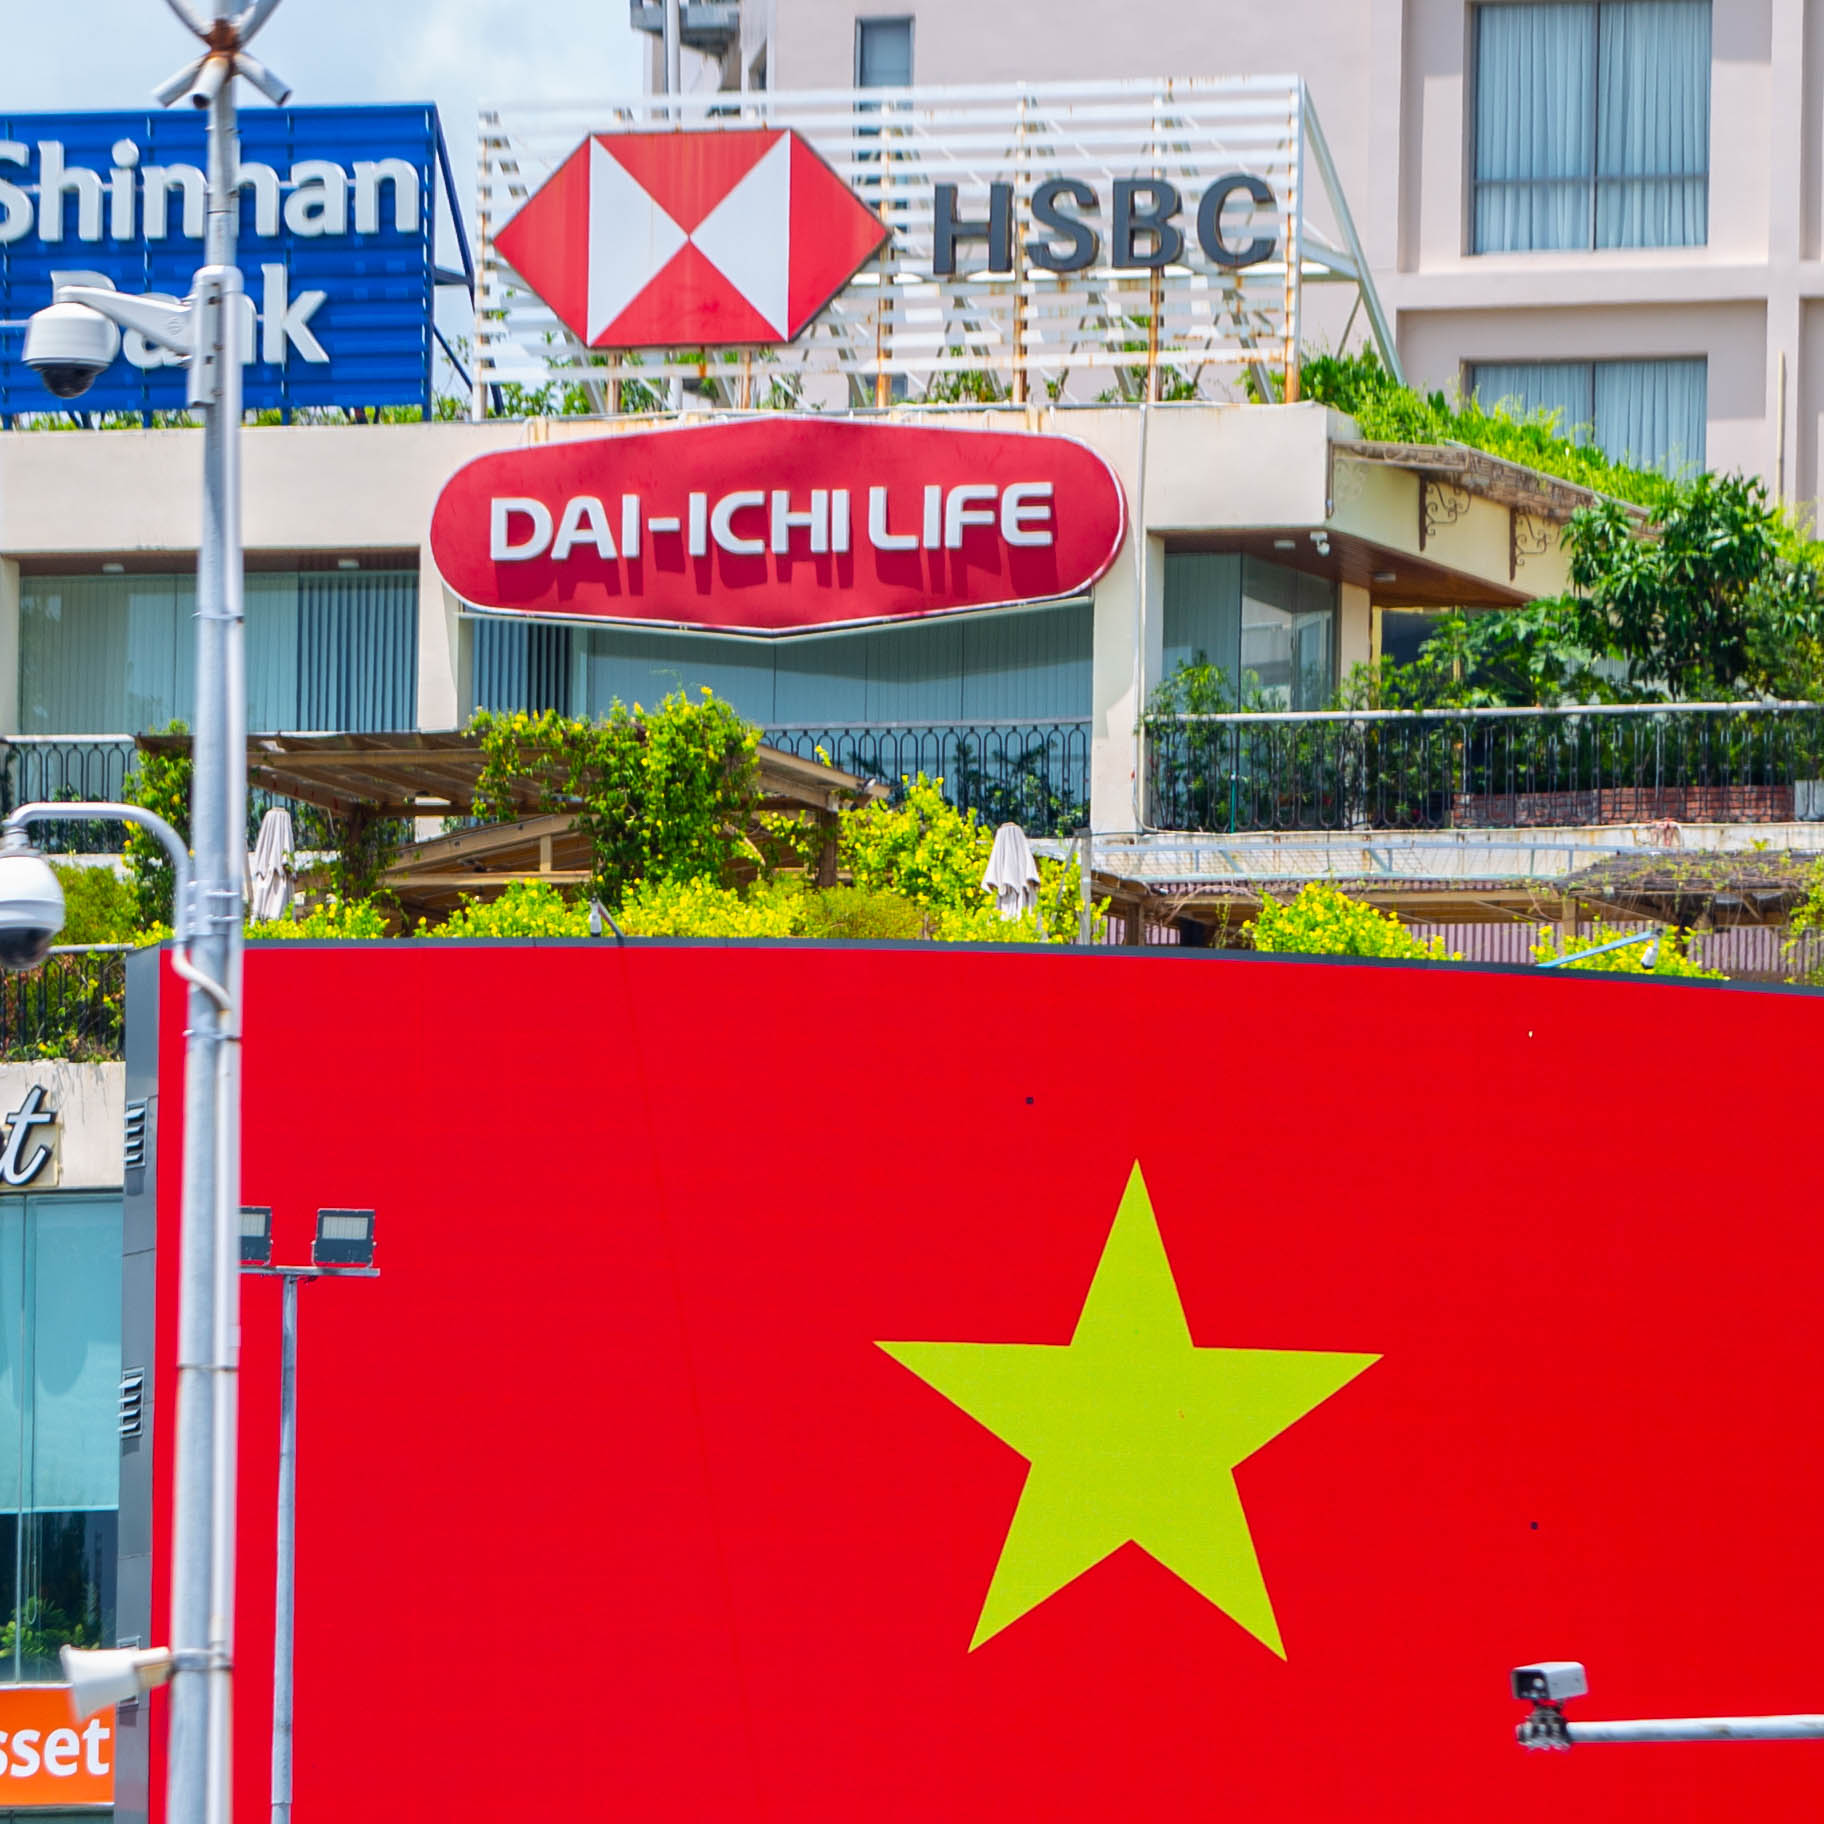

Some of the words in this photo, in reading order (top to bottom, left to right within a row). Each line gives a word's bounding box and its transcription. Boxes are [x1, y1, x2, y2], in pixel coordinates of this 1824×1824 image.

[933, 172, 1277, 275] HSBC
[490, 488, 850, 561] DAI-ICHI
[868, 482, 1054, 550] LIFE
